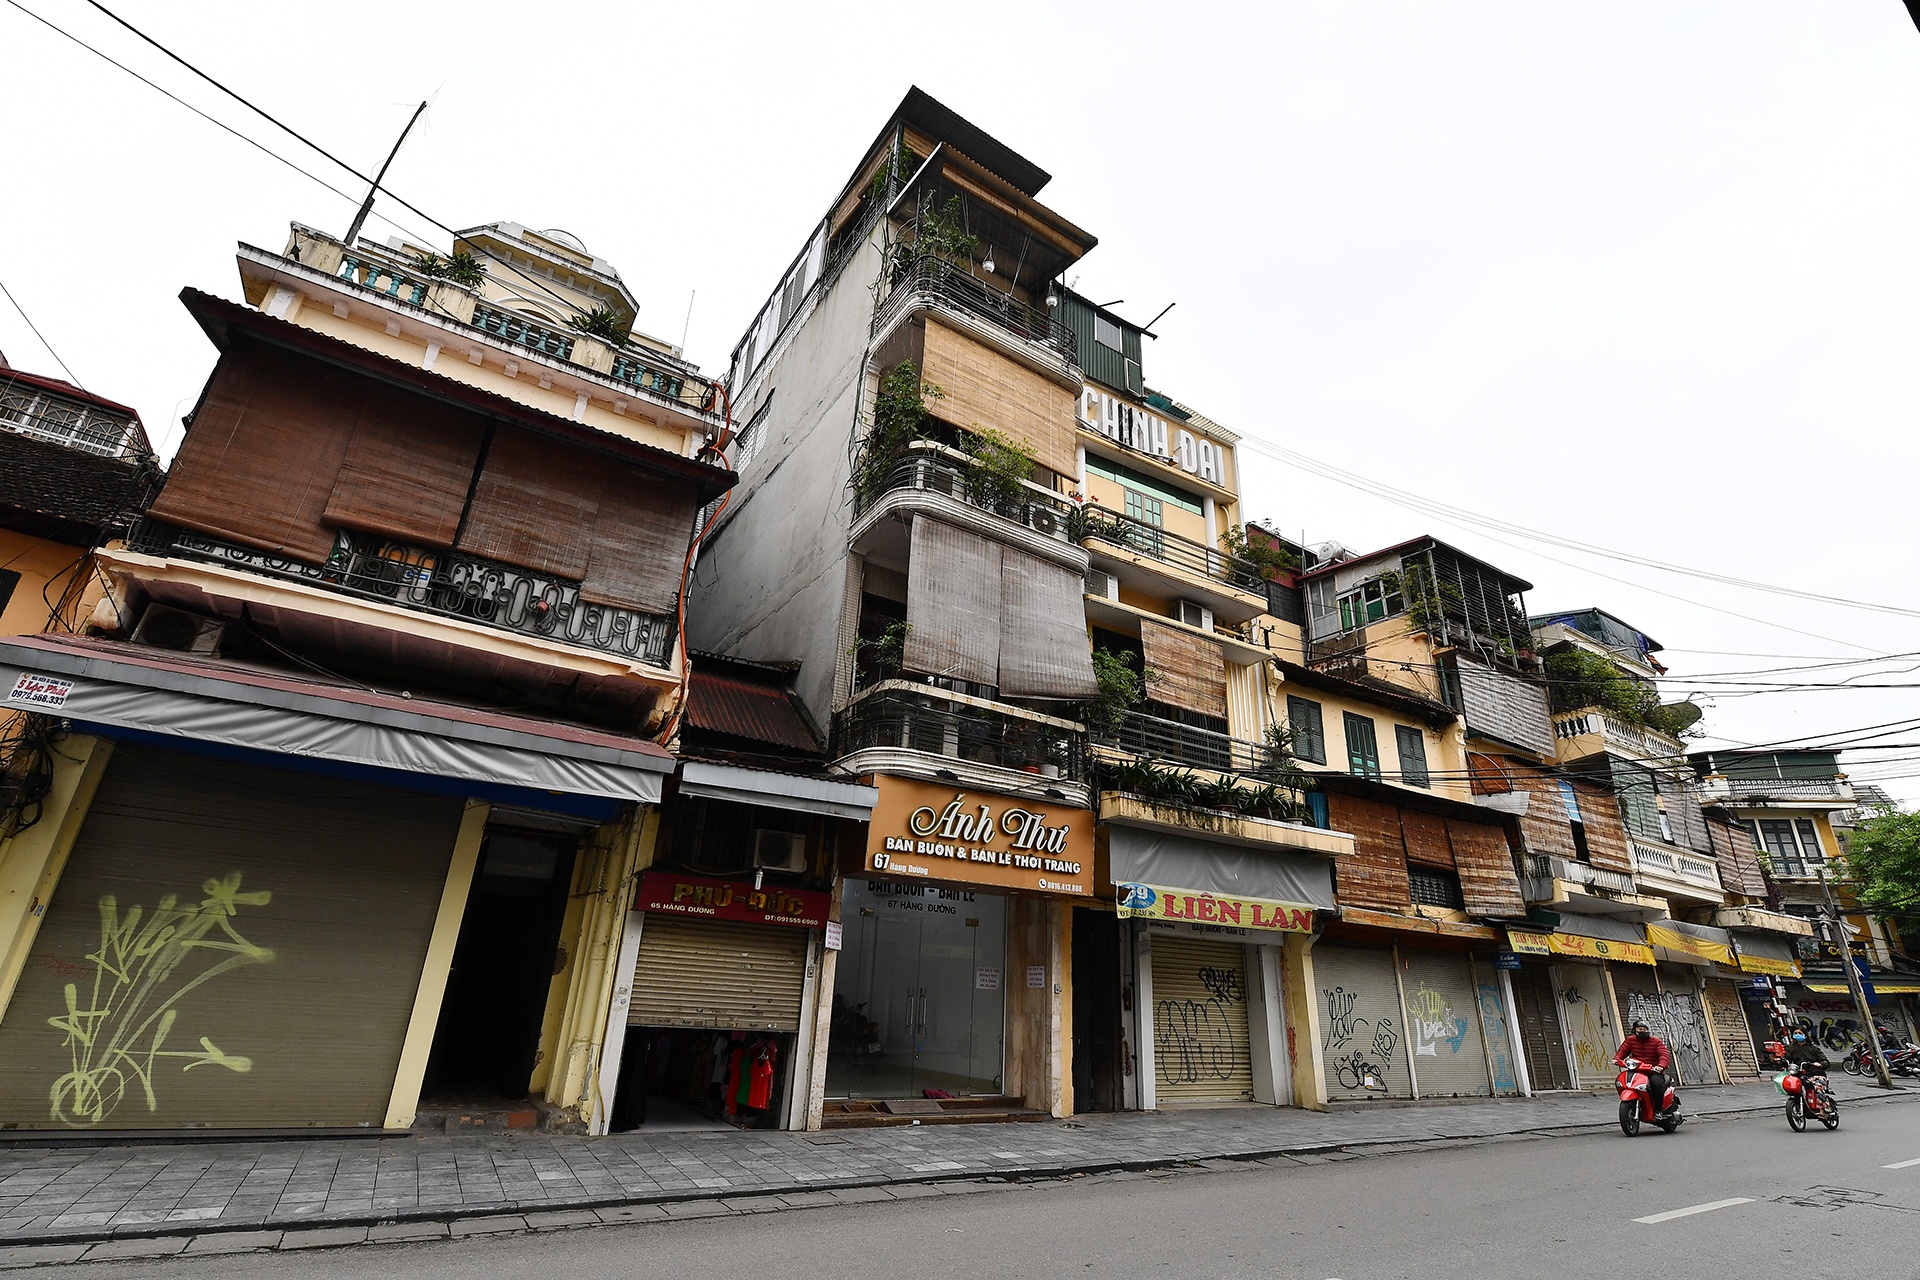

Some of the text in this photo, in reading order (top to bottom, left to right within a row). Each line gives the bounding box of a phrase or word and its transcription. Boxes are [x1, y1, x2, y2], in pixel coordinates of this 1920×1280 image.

[17, 679, 27, 689] 5
[25, 681, 45, 694] Lộc
[11, 689, 65, 705] 0979.568.333
[909, 793, 1070, 854] Ánh Thư
[873, 853, 891, 871] 67
[886, 836, 914, 853] BÁN
[917, 840, 954, 859] BUÔN
[957, 845, 967, 860] &
[970, 848, 996, 864] BÁN
[1044, 858, 1081, 874] TRANG
[650, 902, 661, 910] 65
[663, 903, 685, 912] HÀNG
[888, 900, 957, 915] 67 HÀNG ĐƯỜNG
[1162, 892, 1313, 931] LIÊN LAN
